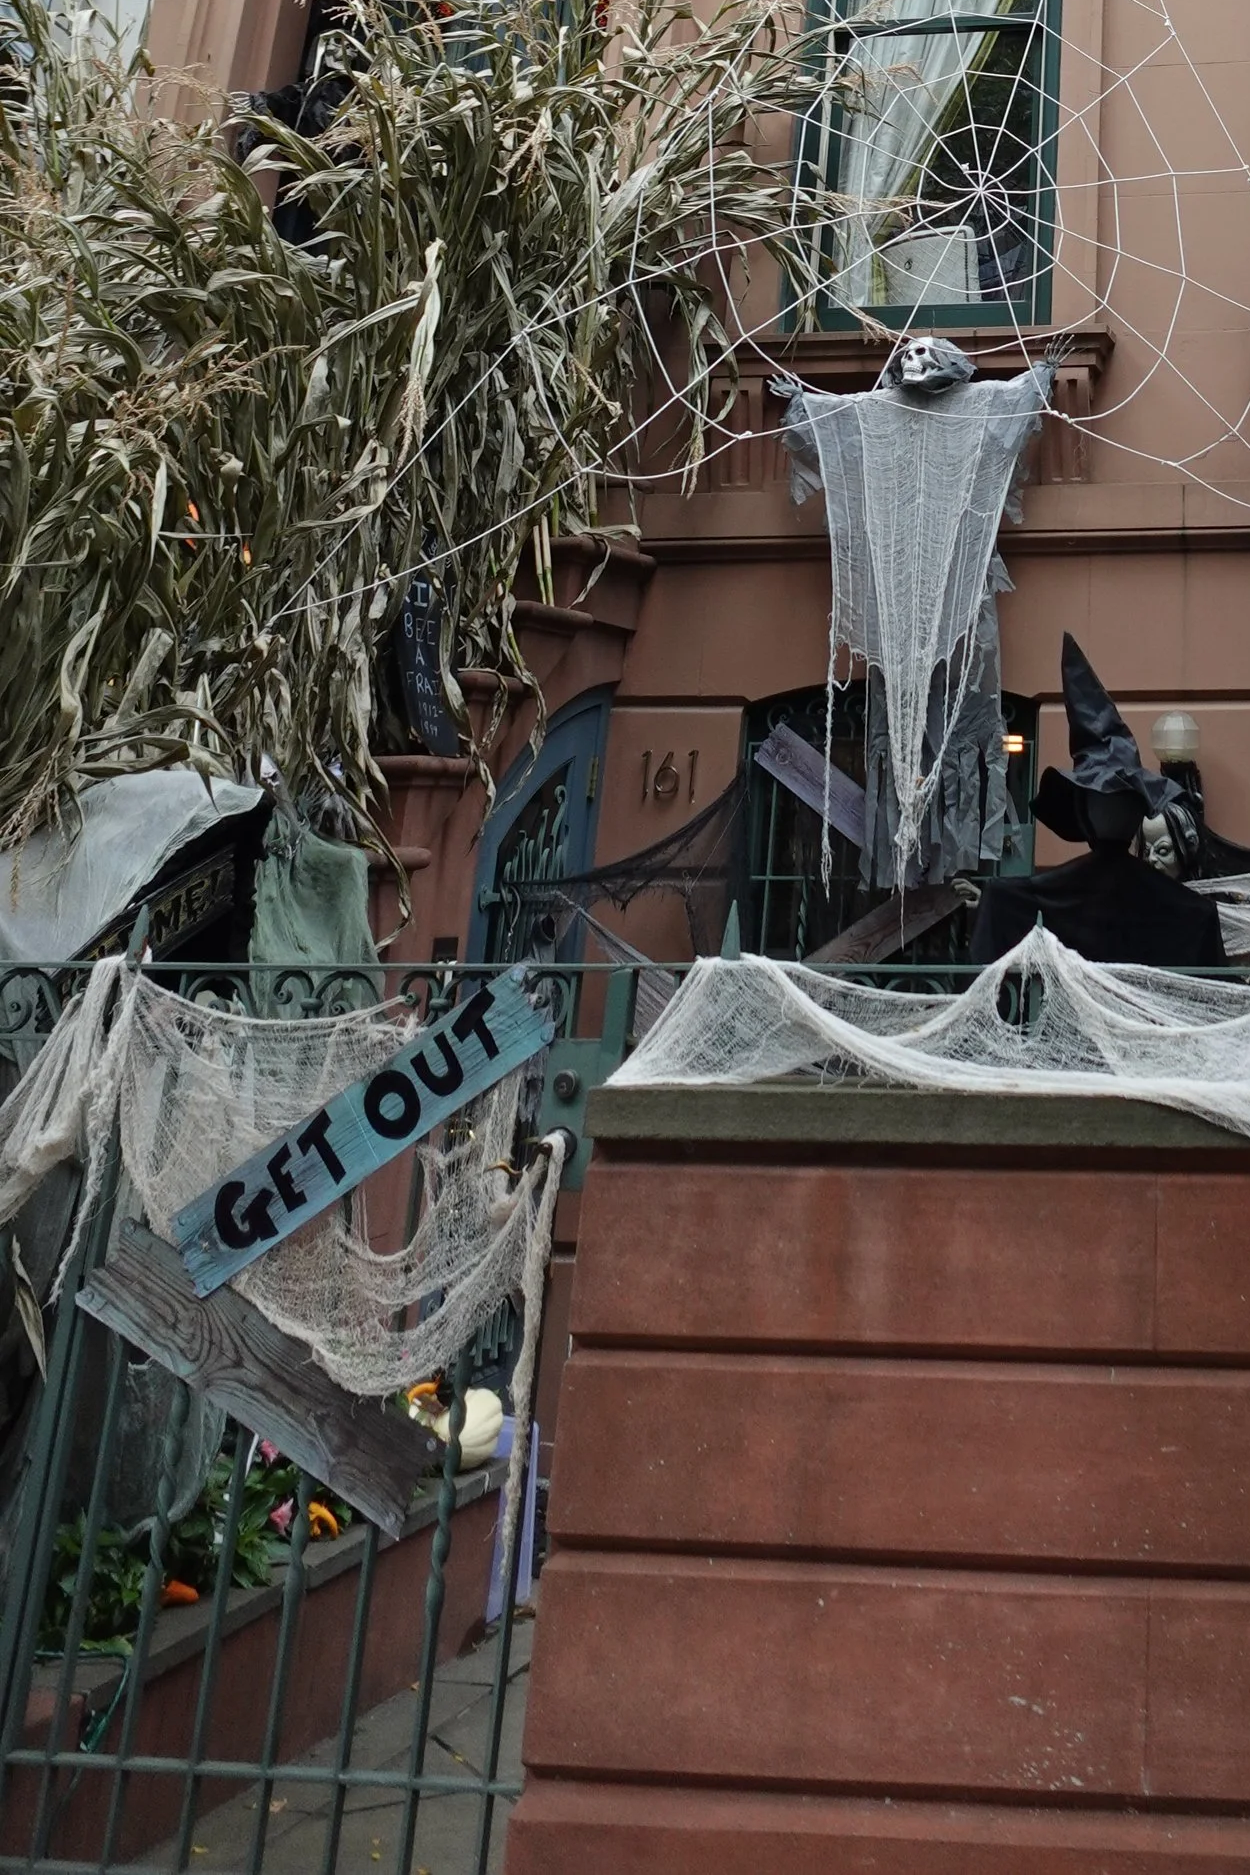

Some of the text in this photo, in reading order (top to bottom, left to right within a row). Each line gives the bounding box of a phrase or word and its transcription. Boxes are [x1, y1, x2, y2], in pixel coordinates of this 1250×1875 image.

[641, 749, 699, 805] 161
[214, 986, 500, 1250] GET OUT
